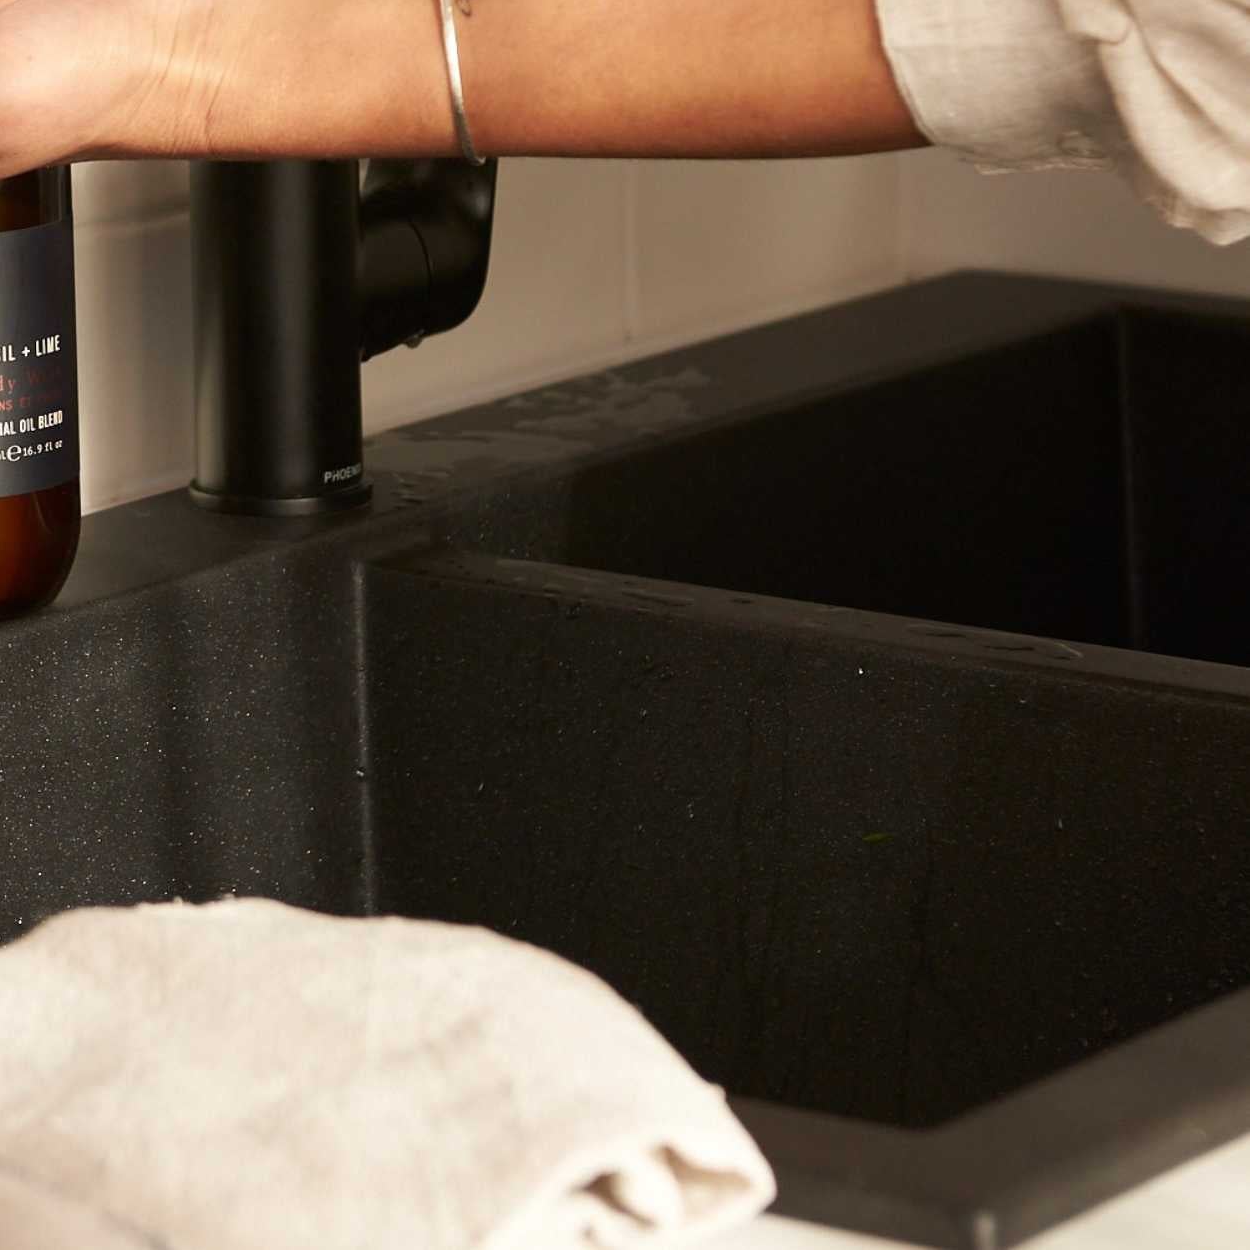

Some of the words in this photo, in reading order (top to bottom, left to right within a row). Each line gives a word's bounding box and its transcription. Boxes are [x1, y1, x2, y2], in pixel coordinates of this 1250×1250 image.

[22, 347, 30, 357] +
[36, 335, 60, 357] LIME
[20, 418, 34, 433] OIL
[38, 411, 62, 429] BLEND
[23, 445, 42, 456] 16.9
